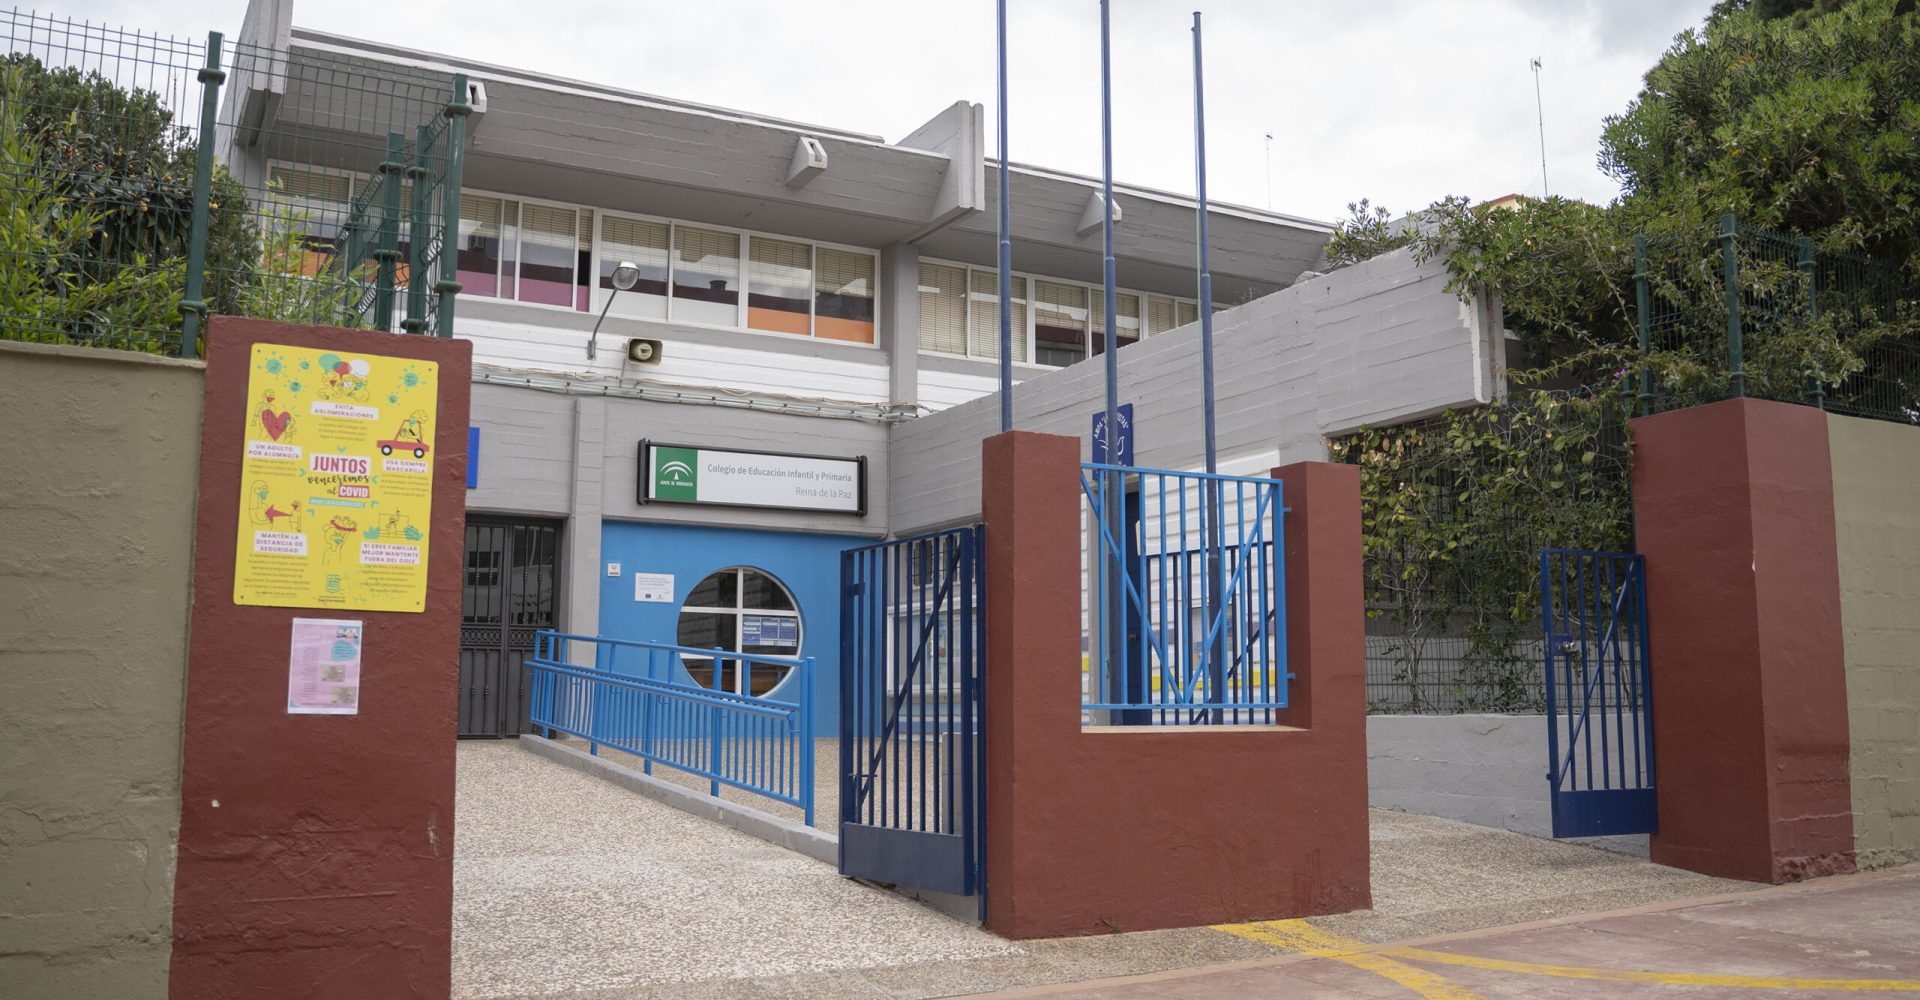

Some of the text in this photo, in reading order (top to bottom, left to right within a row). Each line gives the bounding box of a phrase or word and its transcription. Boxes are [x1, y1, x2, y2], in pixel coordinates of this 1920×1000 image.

[312, 455, 367, 474] JUNTOS
[707, 463, 852, 482] Colegio de Educación Infantil y Primaria
[307, 474, 370, 485] venceremos
[327, 486, 369, 498] al COVID
[795, 486, 852, 500] Reina de la Paz
[256, 539, 293, 547] DISTANCIA
